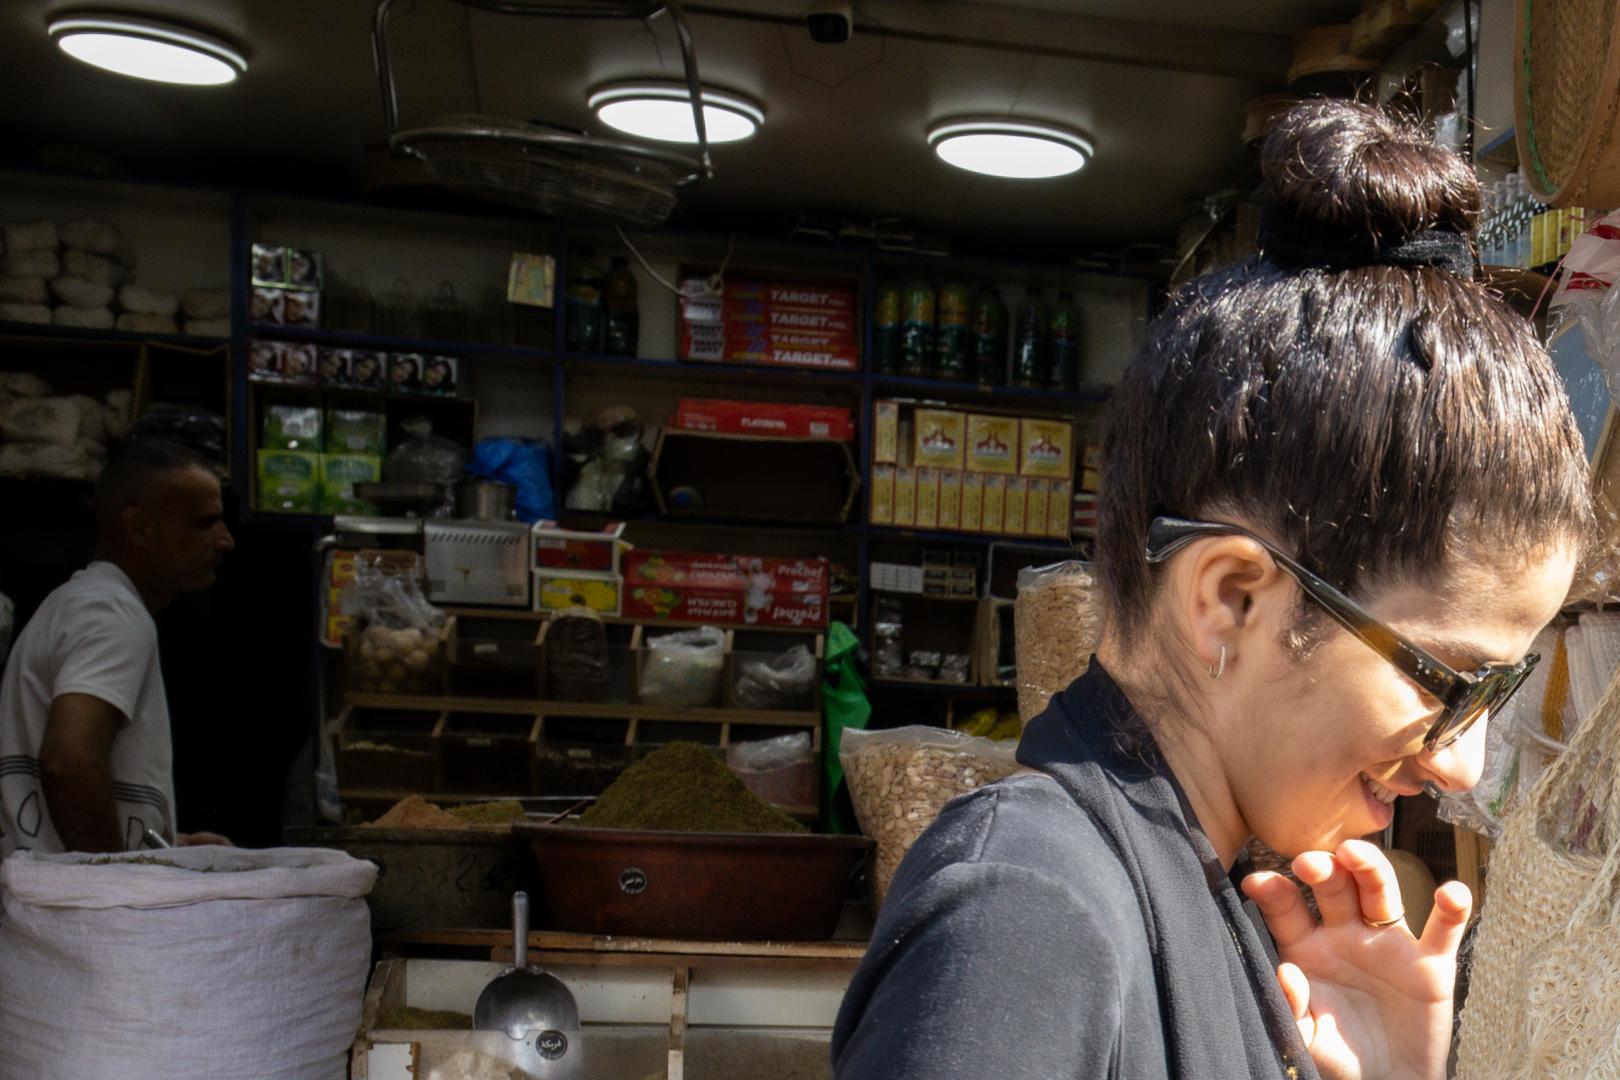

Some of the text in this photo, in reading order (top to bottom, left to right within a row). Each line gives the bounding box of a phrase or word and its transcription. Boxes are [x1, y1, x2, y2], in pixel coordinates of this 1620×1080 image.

[770, 289, 830, 303] TARGET
[770, 312, 830, 326] TARGET
[772, 350, 833, 366] TARGET
[777, 563, 824, 578] ProChef
[772, 607, 821, 622] ProChef
